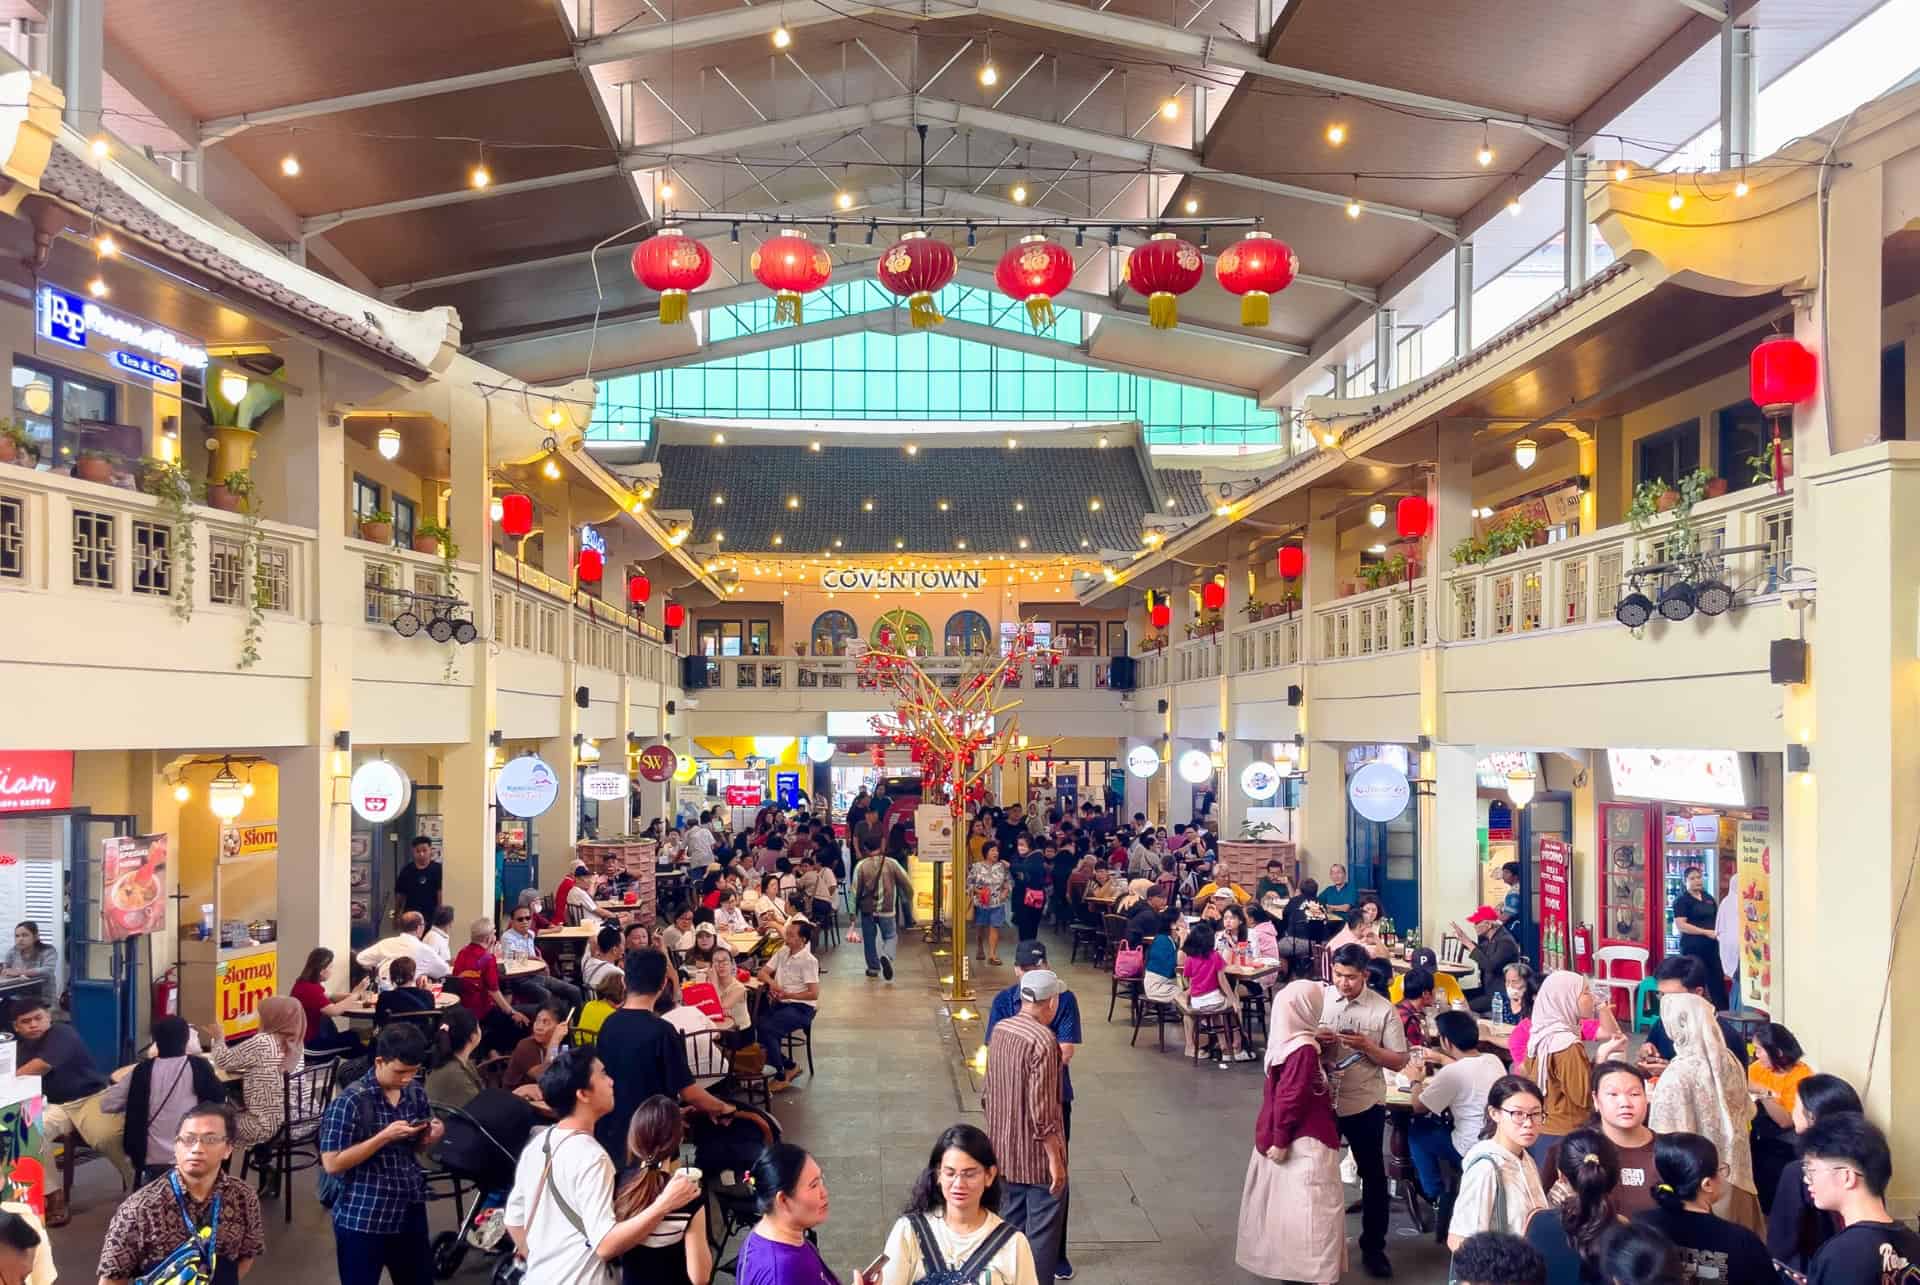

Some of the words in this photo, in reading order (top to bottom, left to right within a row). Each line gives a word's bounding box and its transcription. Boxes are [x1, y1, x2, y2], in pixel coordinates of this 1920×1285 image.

[140, 360, 151, 373] &
[823, 569, 980, 589] COVENTOWN
[1420, 955, 1428, 966] P
[222, 962, 275, 985] Siomay
